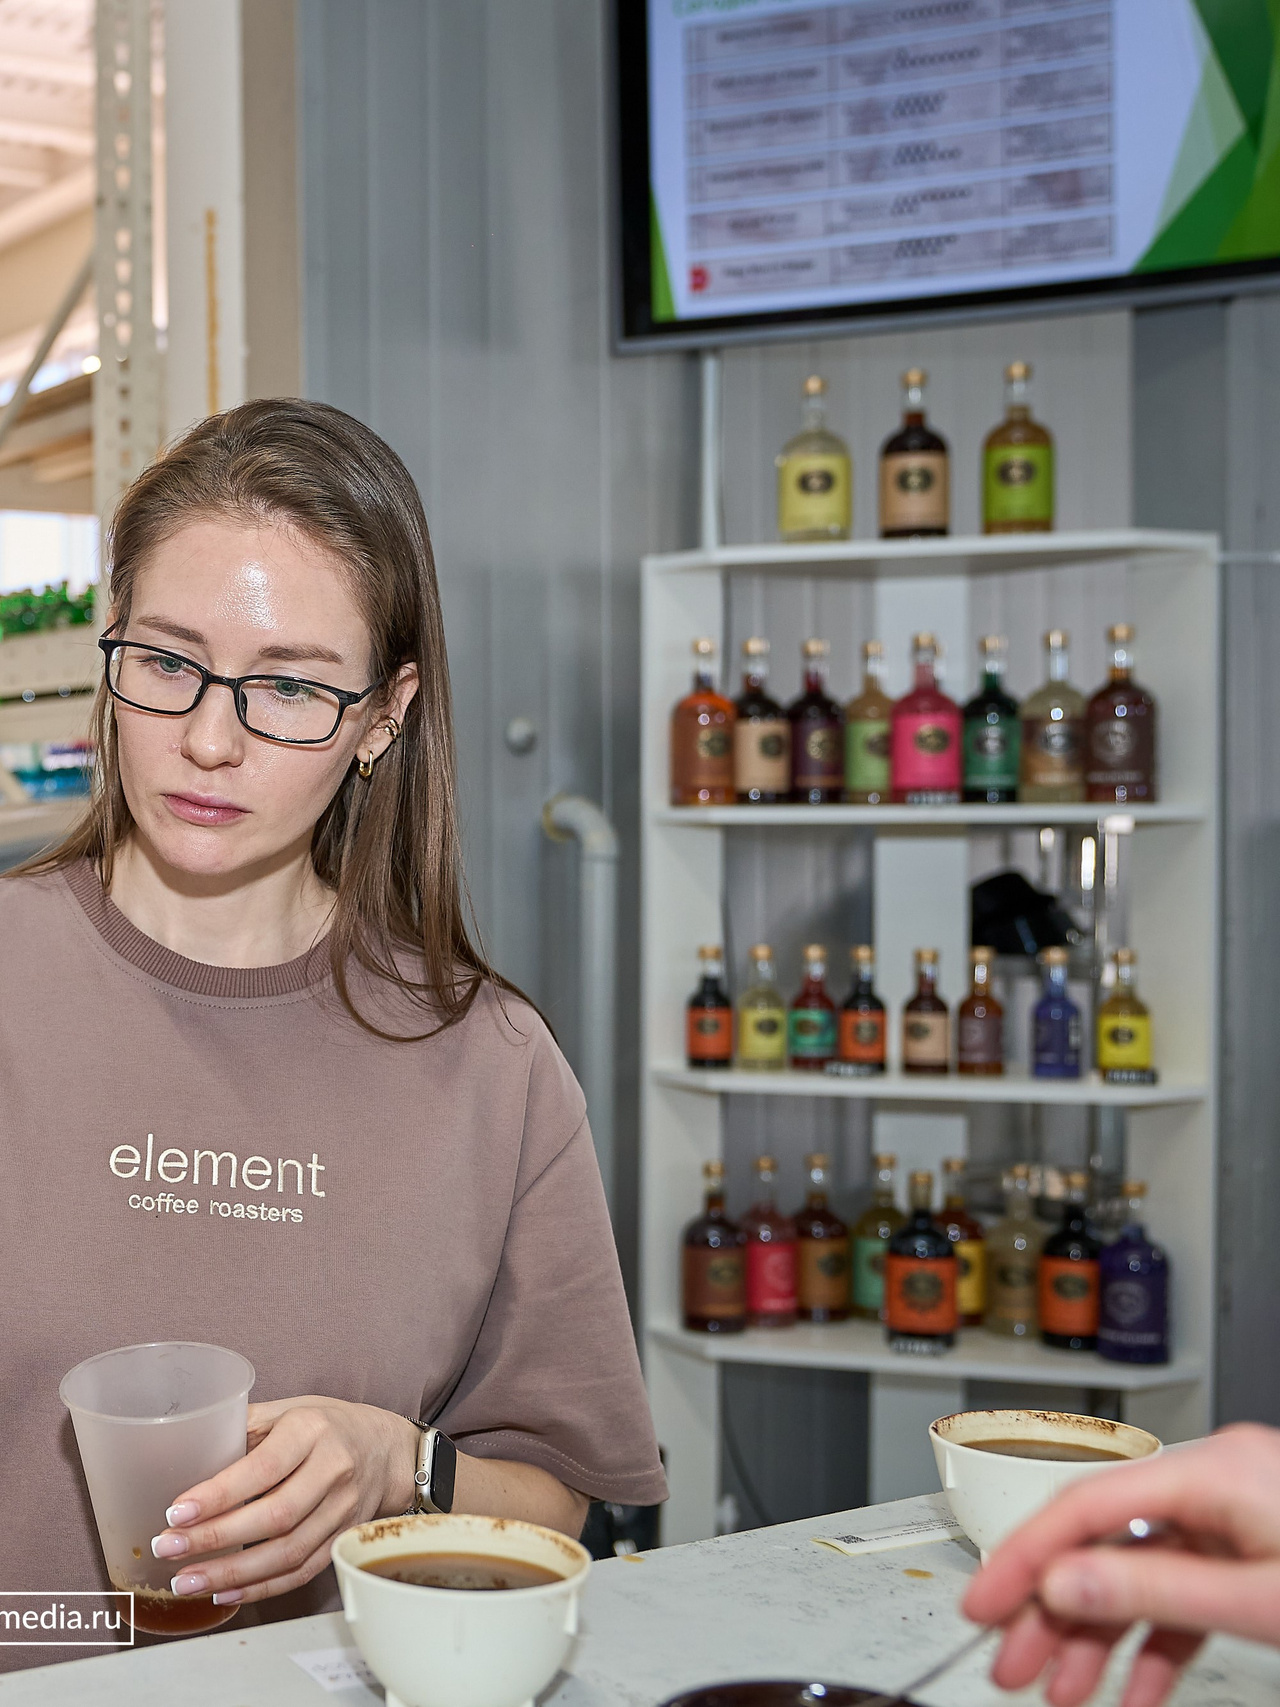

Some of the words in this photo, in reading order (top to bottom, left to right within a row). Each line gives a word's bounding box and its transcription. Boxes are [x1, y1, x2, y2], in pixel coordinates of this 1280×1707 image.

[109, 1133, 325, 1197] element
[128, 1192, 199, 1214] coffee
[209, 1199, 304, 1223] roasters
